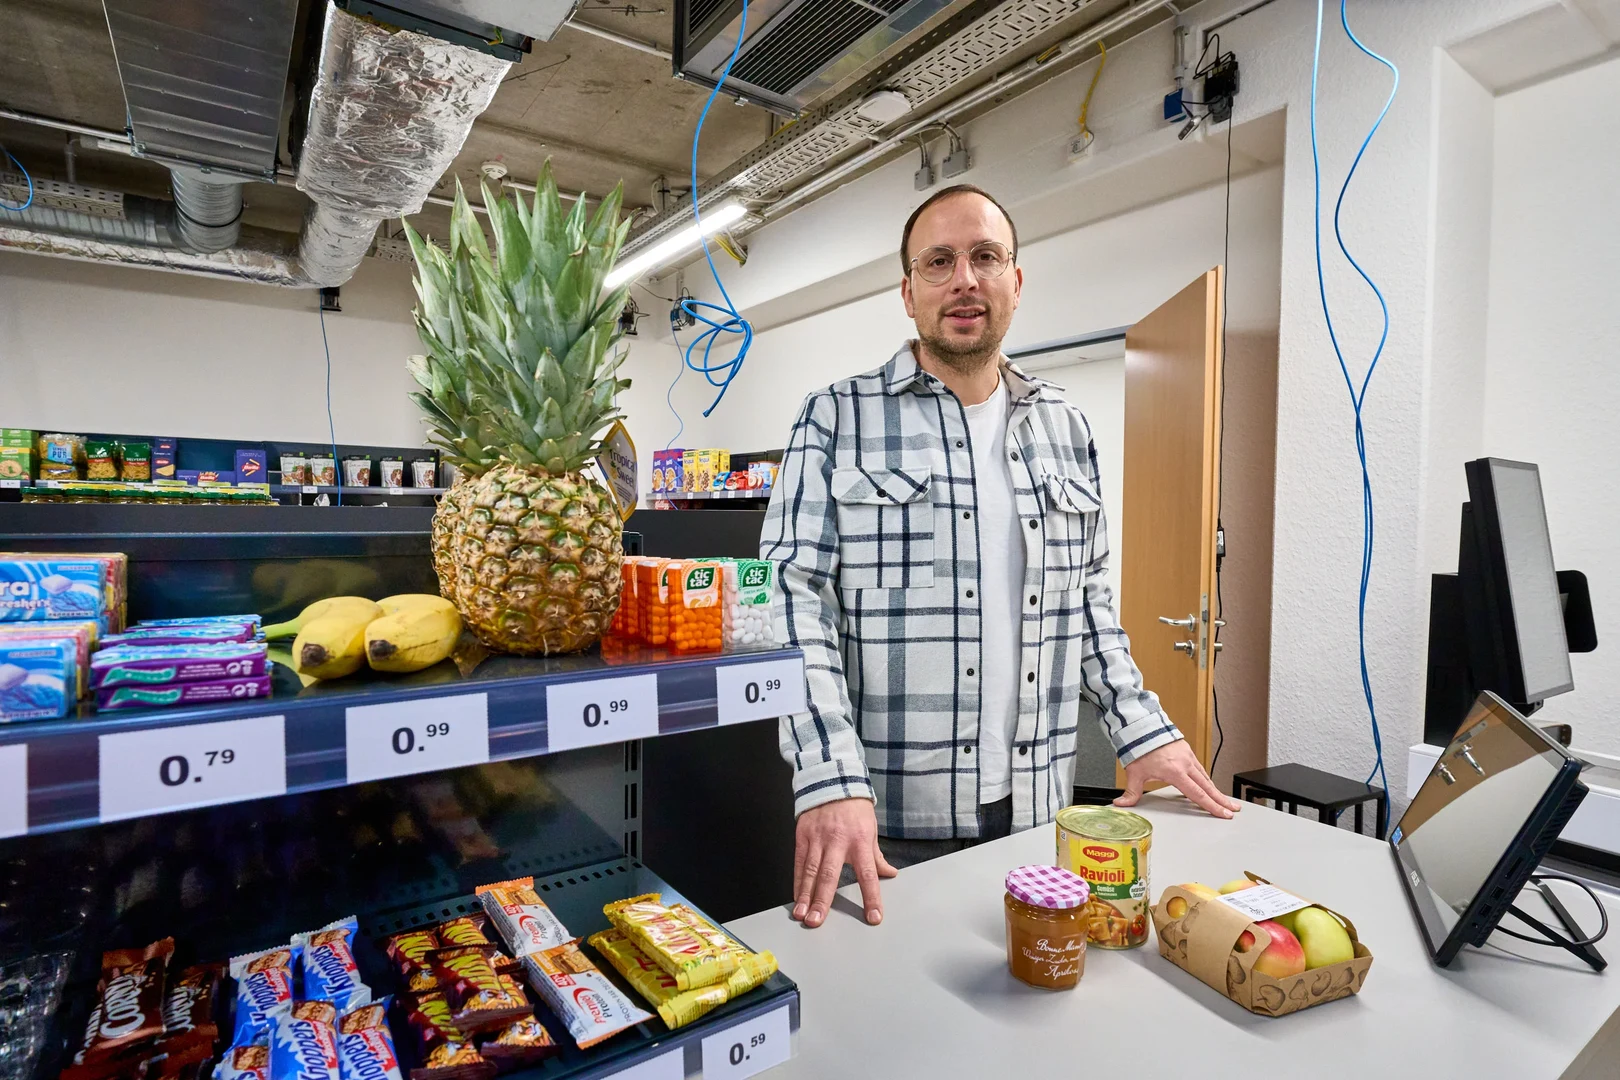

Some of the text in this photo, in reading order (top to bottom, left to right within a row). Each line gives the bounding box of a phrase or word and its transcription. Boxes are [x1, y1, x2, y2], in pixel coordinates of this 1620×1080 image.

[610, 449, 635, 473] Tropica
[616, 466, 634, 488] Swee
[690, 578, 710, 587] tac
[694, 569, 711, 579] tic
[745, 576, 764, 584] tac
[750, 568, 765, 577] tic
[744, 679, 781, 703] 0.99
[582, 699, 629, 728] 0.99
[391, 722, 450, 755] 0.99
[160, 749, 235, 787] 0.79
[1086, 848, 1115, 858] Maggi
[1080, 865, 1125, 883] Ravioli
[525, 920, 542, 945] Premier
[1036, 938, 1063, 954] Bonne
[310, 945, 356, 994] Knoppers
[100, 975, 146, 1039] CORNY
[580, 994, 607, 1025] Premier
[591, 992, 613, 1018] Protein
[617, 997, 632, 1022] PROTEIN
[338, 1034, 389, 1080] noppers
[729, 1033, 766, 1066] 0.59
